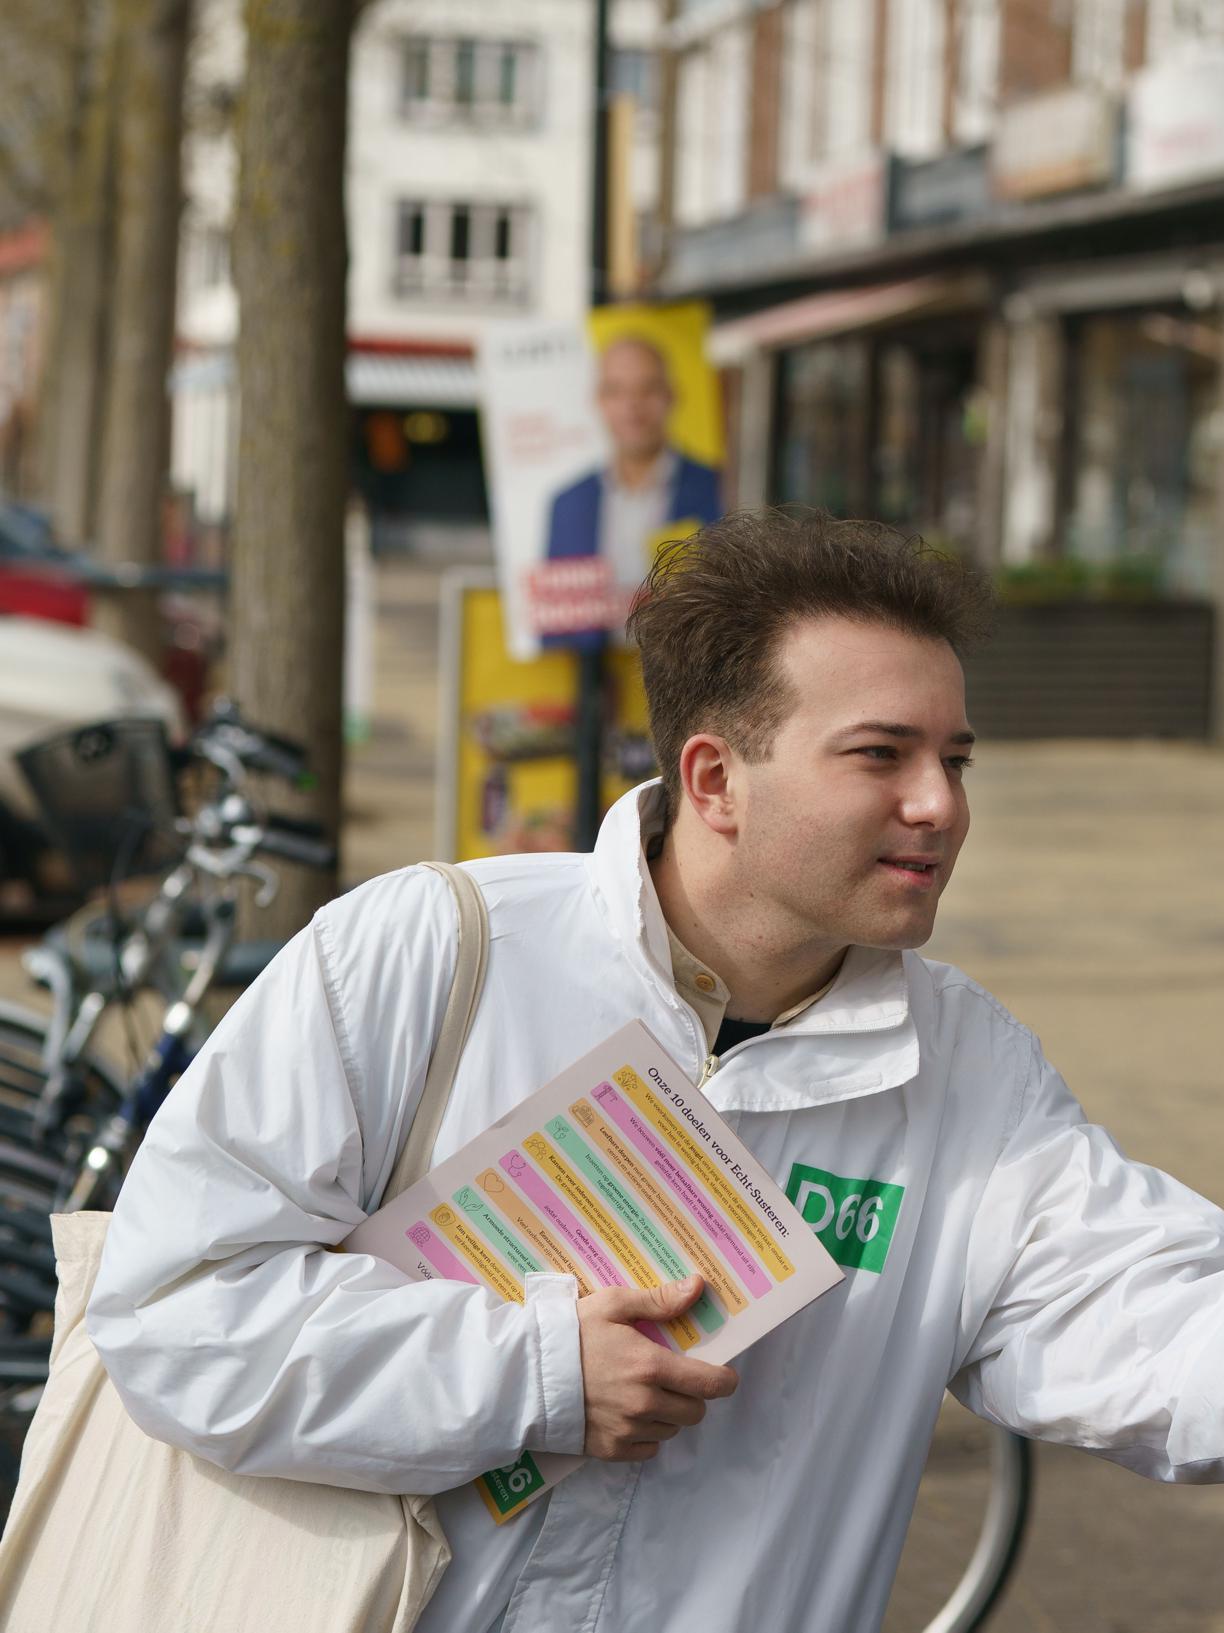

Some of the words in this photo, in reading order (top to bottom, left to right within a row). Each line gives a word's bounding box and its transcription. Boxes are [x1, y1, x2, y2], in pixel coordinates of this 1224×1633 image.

[647, 1066, 673, 1096] Onze
[669, 1093, 685, 1108] 10
[680, 1106, 713, 1143] doelen
[710, 1140, 734, 1166] voor
[729, 1163, 791, 1239] Echt-Susteren:
[794, 1179, 883, 1243] D66
